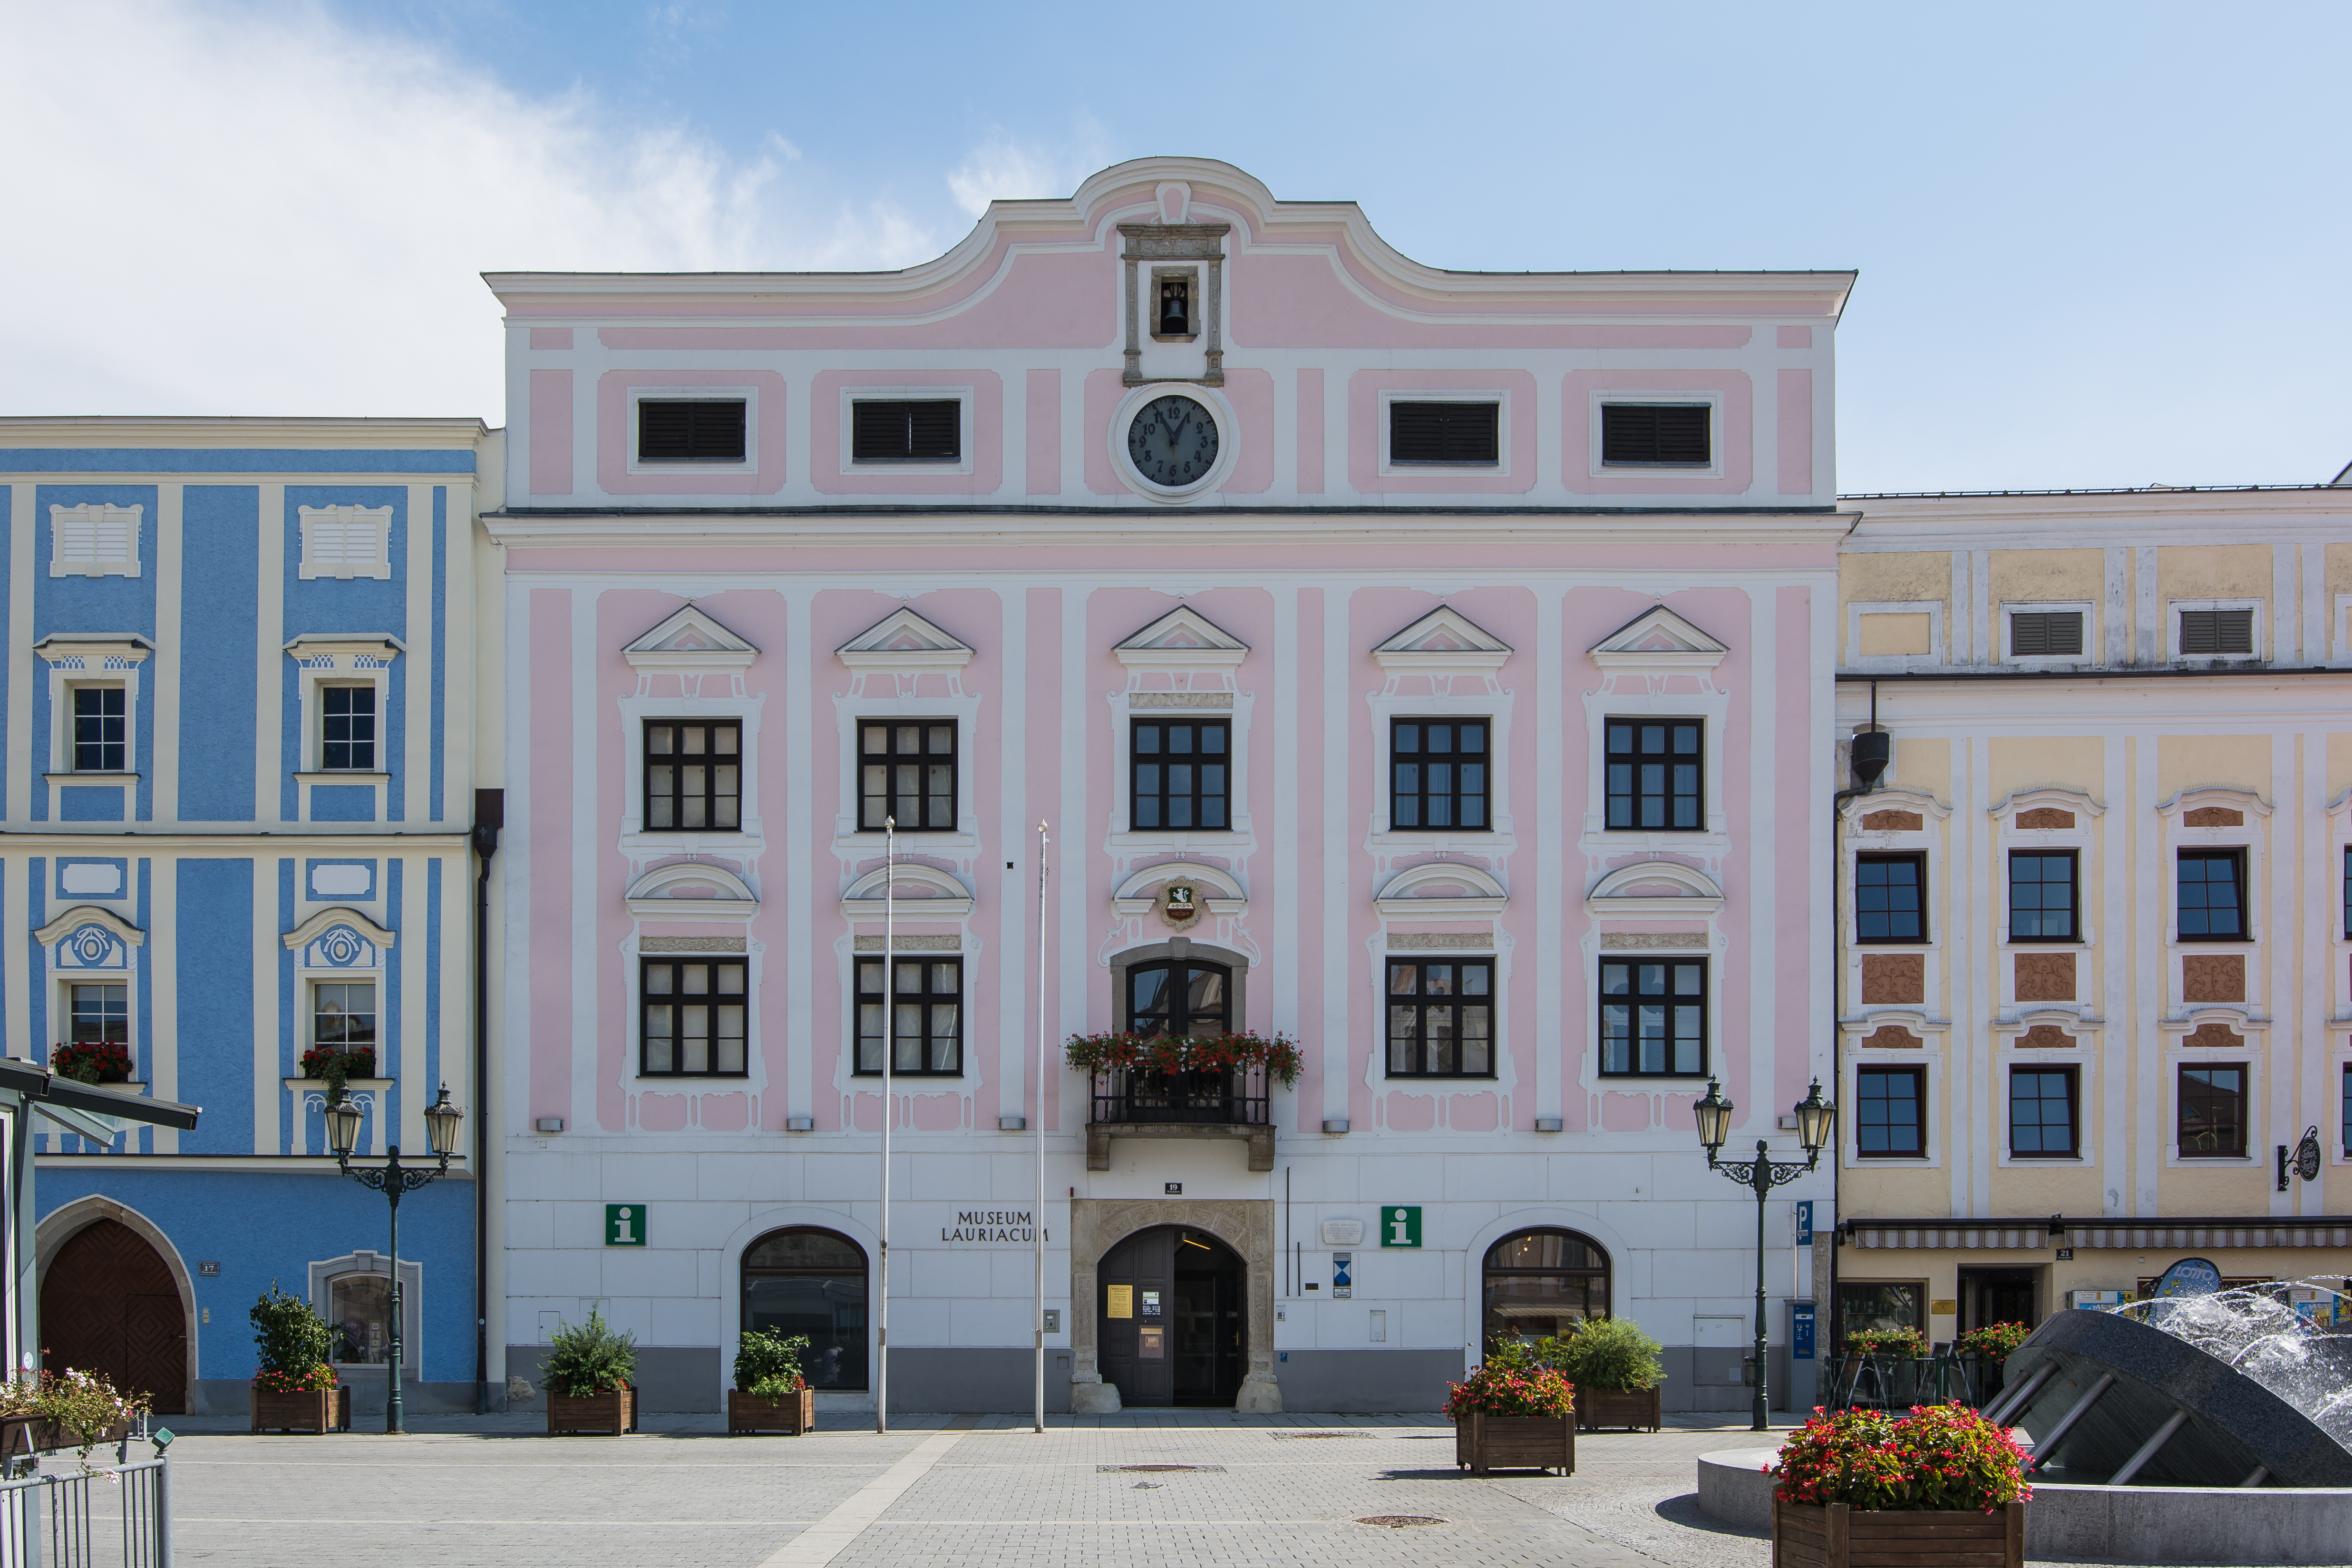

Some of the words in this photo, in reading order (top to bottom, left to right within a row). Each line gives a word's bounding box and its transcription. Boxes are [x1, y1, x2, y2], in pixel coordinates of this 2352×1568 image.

[1167, 407, 1180, 419] 12
[1143, 423, 1156, 436] 10
[1196, 421, 1204, 434] 2
[1139, 436, 1147, 448] 9
[1201, 436, 1208, 448] 3
[1144, 450, 1152, 462] 8
[1194, 450, 1202, 463] 4
[1157, 460, 1164, 473] 7
[1169, 465, 1176, 477] 6
[1184, 461, 1191, 474] 5
[2301, 1147, 2317, 1161] Tabak
[2301, 1157, 2317, 1172] Trafik
[958, 1211, 1031, 1225] MUSEUM
[1799, 1206, 1807, 1230] P
[2173, 1266, 2215, 1281] LOTTO
